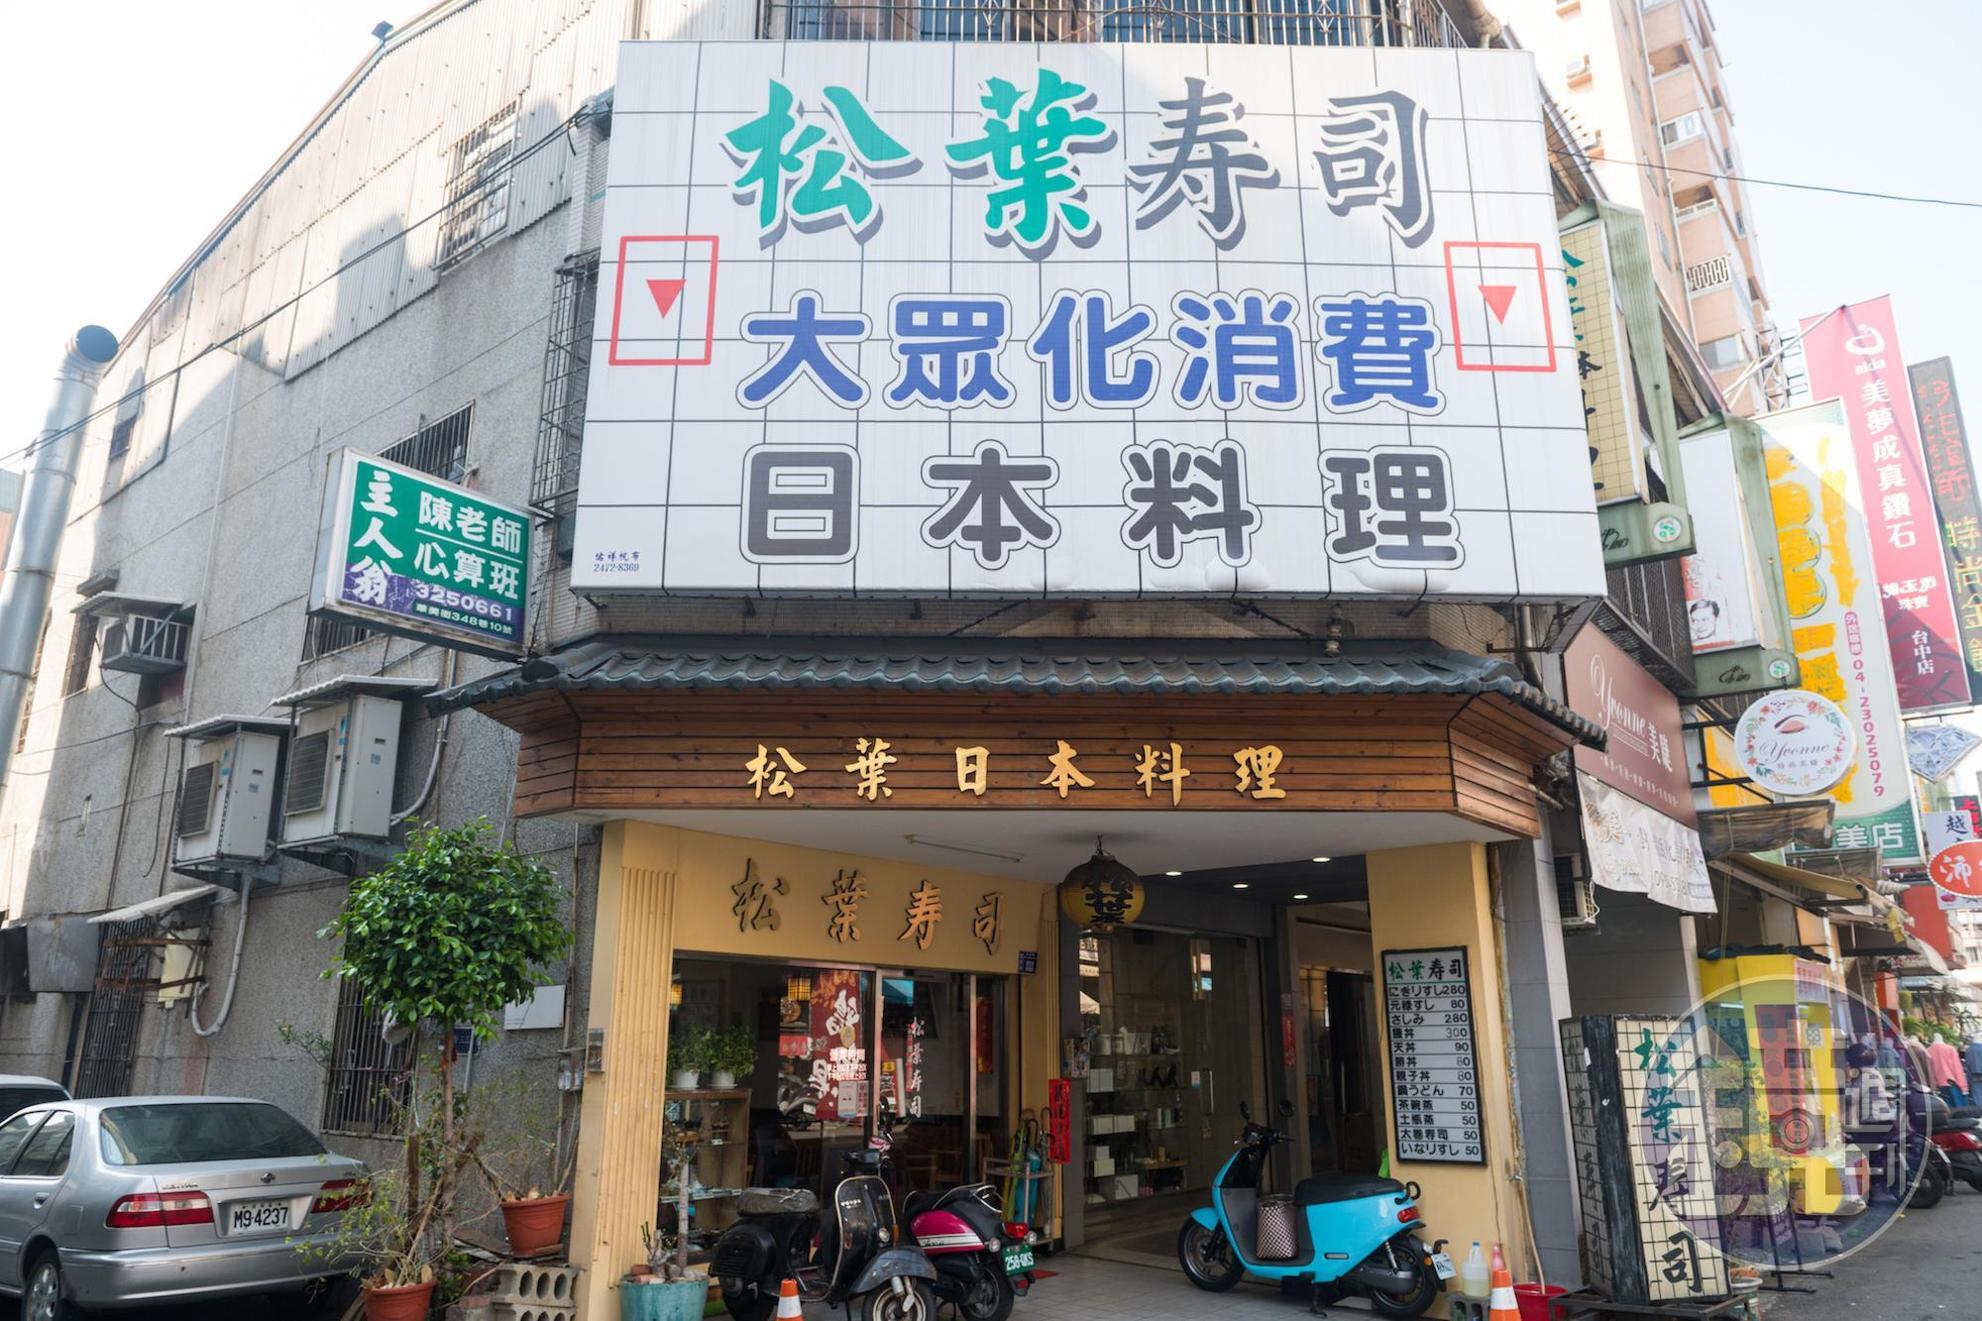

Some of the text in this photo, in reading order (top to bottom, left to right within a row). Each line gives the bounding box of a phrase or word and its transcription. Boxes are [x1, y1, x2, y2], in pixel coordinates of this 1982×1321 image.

[722, 68, 1434, 258] 松葉寿司
[738, 291, 1443, 413] 大眾化消費
[1860, 379, 1916, 548] 美夢成真鑽石
[742, 441, 1462, 568] 日本料理
[352, 470, 404, 605] 主人翁
[418, 491, 522, 554] 陳老師
[414, 541, 520, 600] 心算班
[415, 583, 513, 621] 3250661
[1912, 630, 1935, 674] 台中店
[1590, 654, 1646, 738] Yvonne
[1853, 659, 1885, 797] 04-23025079
[1760, 742, 1829, 763] Yvonne
[745, 738, 1287, 806] 松葉日本料理
[731, 858, 1004, 956] 松葉寿司
[1388, 957, 1462, 980] 松葉寿司
[1443, 984, 1466, 995] 280
[1451, 999, 1465, 1009] 80
[1391, 1012, 1468, 1025] さしみ 280
[1446, 1027, 1468, 1039] 300
[1455, 1042, 1469, 1052] 90
[1458, 1070, 1472, 1081] 80
[1459, 1086, 1473, 1096] 70
[1461, 1101, 1475, 1111] 50
[1462, 1116, 1476, 1126] 50
[1464, 1131, 1478, 1140] 50
[1401, 1142, 1479, 1156] いなりすし 50
[1634, 1028, 1703, 1294] 松葉寿司
[234, 1207, 288, 1228] M9-4237
